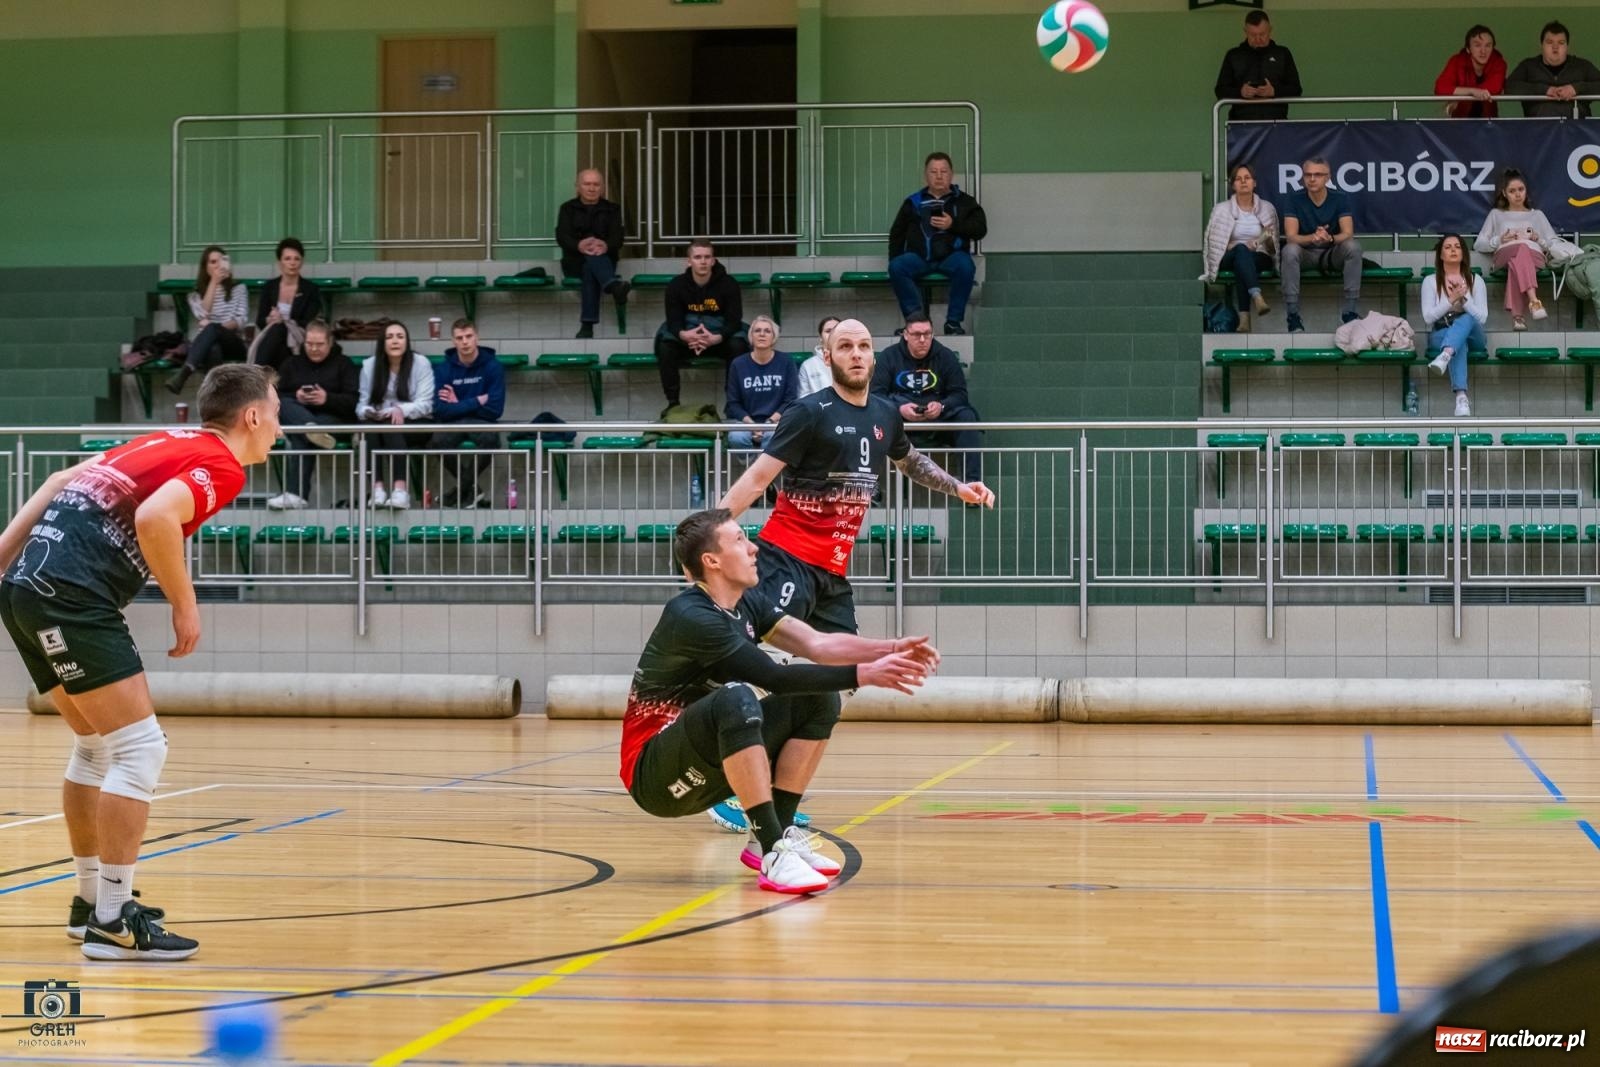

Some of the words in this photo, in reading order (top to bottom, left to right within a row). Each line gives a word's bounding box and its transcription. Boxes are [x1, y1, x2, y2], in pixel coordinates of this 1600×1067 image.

[1278, 150, 1496, 194] RCIBÓRZ
[743, 375, 782, 389] GANT
[860, 437, 870, 466] 9
[779, 581, 796, 607] 9
